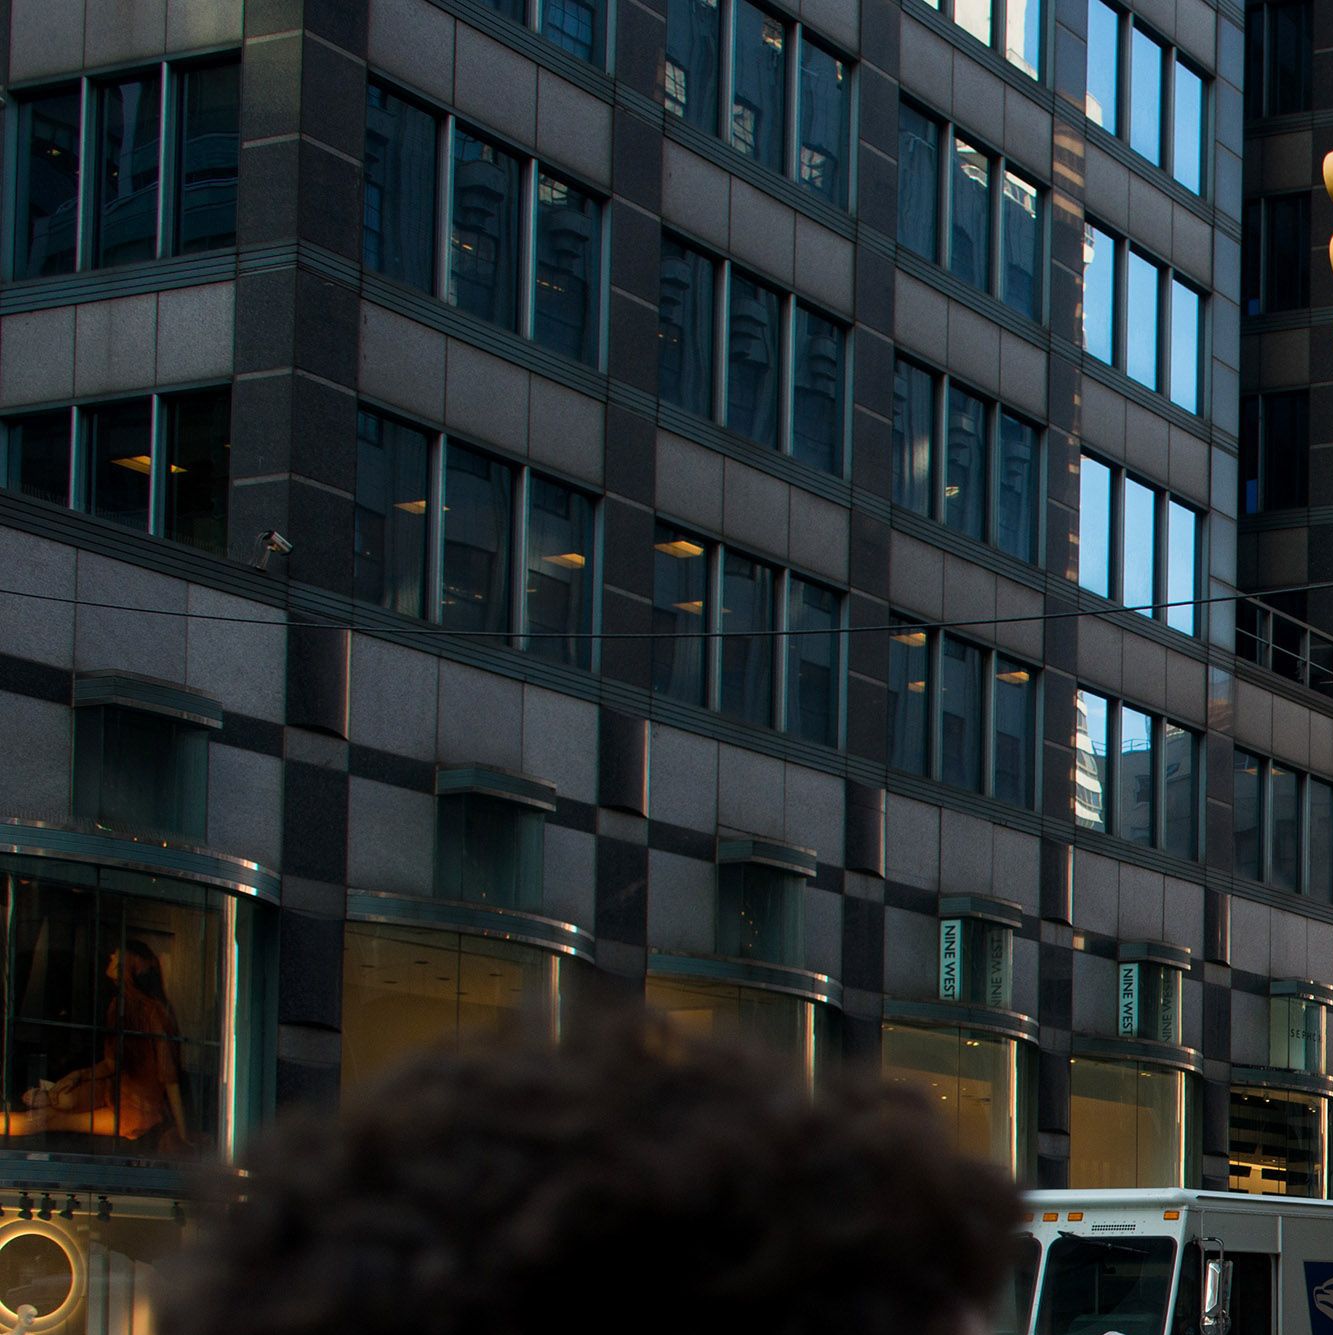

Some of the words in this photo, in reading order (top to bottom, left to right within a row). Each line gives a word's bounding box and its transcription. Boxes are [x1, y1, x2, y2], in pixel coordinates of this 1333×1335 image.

[943, 924, 957, 960] NINE
[943, 962, 956, 1000] WEST
[1122, 967, 1134, 1000] NINE
[1122, 1001, 1134, 1037] WEST
